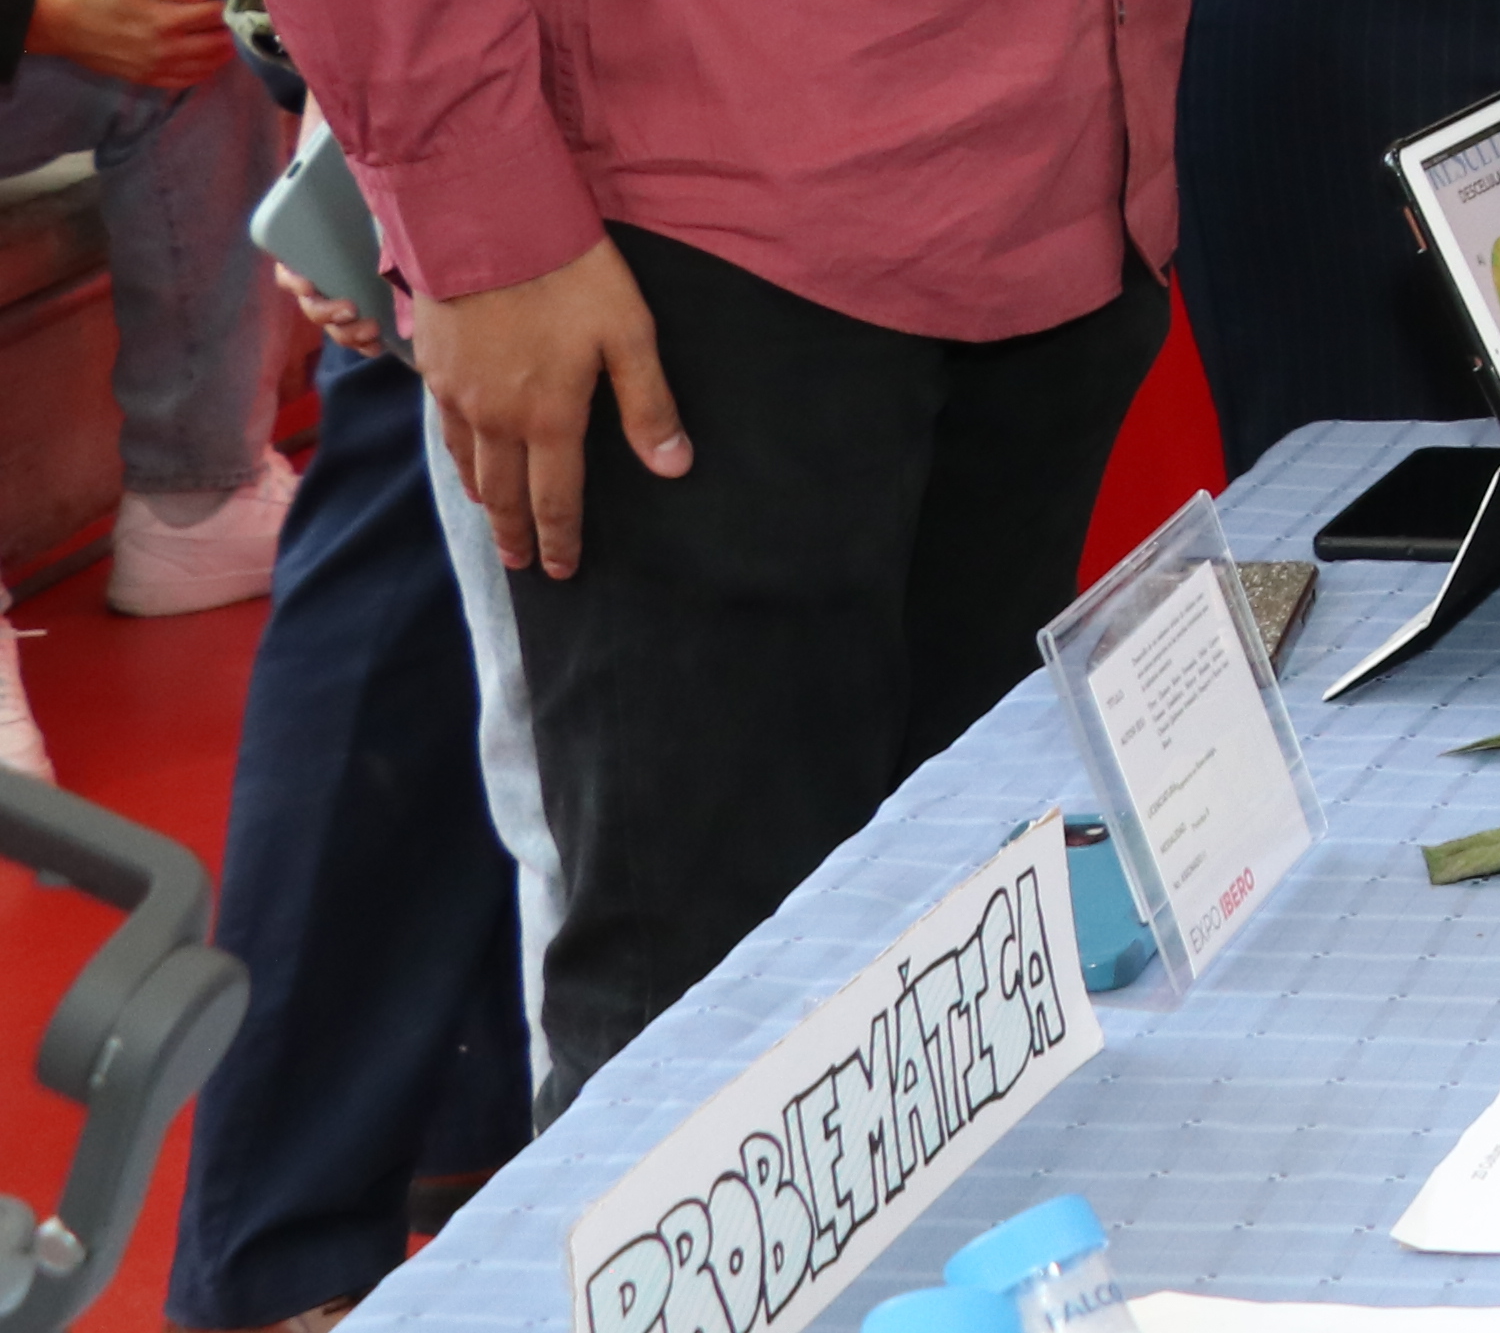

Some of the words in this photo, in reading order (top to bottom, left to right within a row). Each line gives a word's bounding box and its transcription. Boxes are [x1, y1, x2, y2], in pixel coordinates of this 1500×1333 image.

[1189, 905, 1222, 956] EXPO
[1219, 866, 1256, 921] IBERO
[585, 866, 1066, 1333] PROBLEMÁTICA
